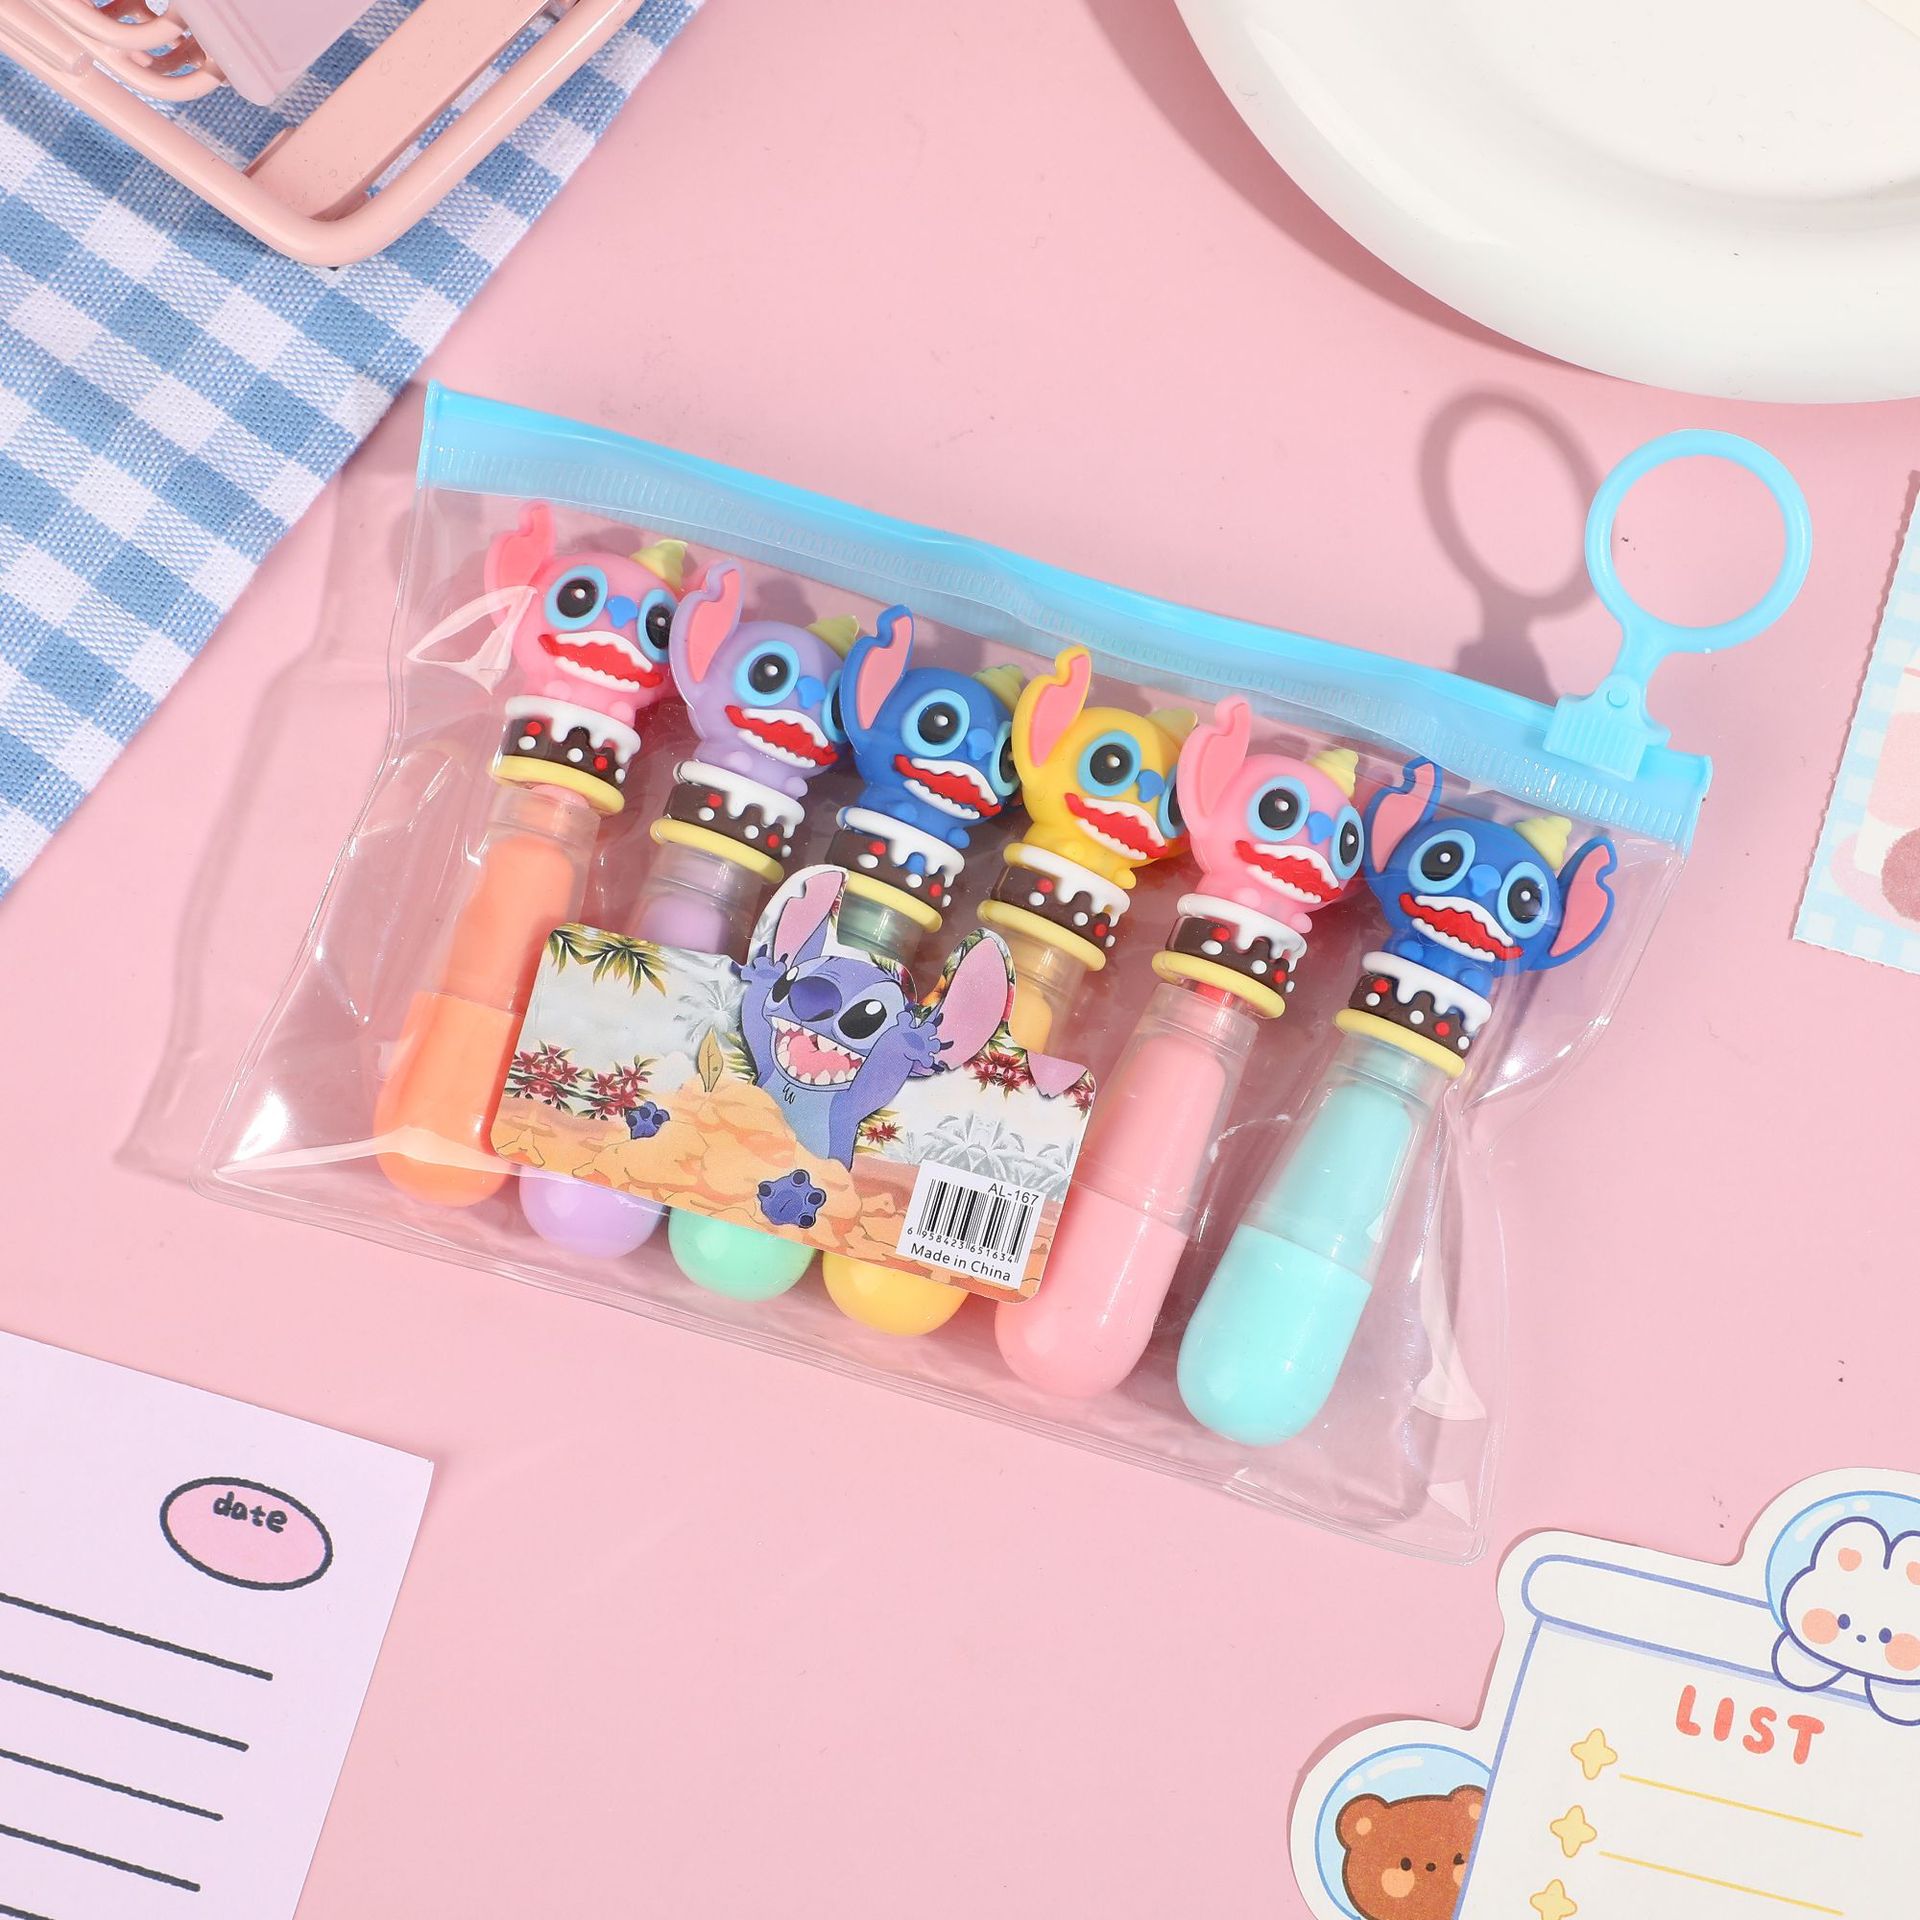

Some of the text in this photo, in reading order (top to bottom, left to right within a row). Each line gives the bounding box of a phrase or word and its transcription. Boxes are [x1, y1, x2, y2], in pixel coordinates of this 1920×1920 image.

[988, 1182, 1039, 1206] AL-167
[910, 1242, 1011, 1282] Made in China
[213, 1491, 288, 1533] date
[1675, 1684, 1825, 1765] LIST
